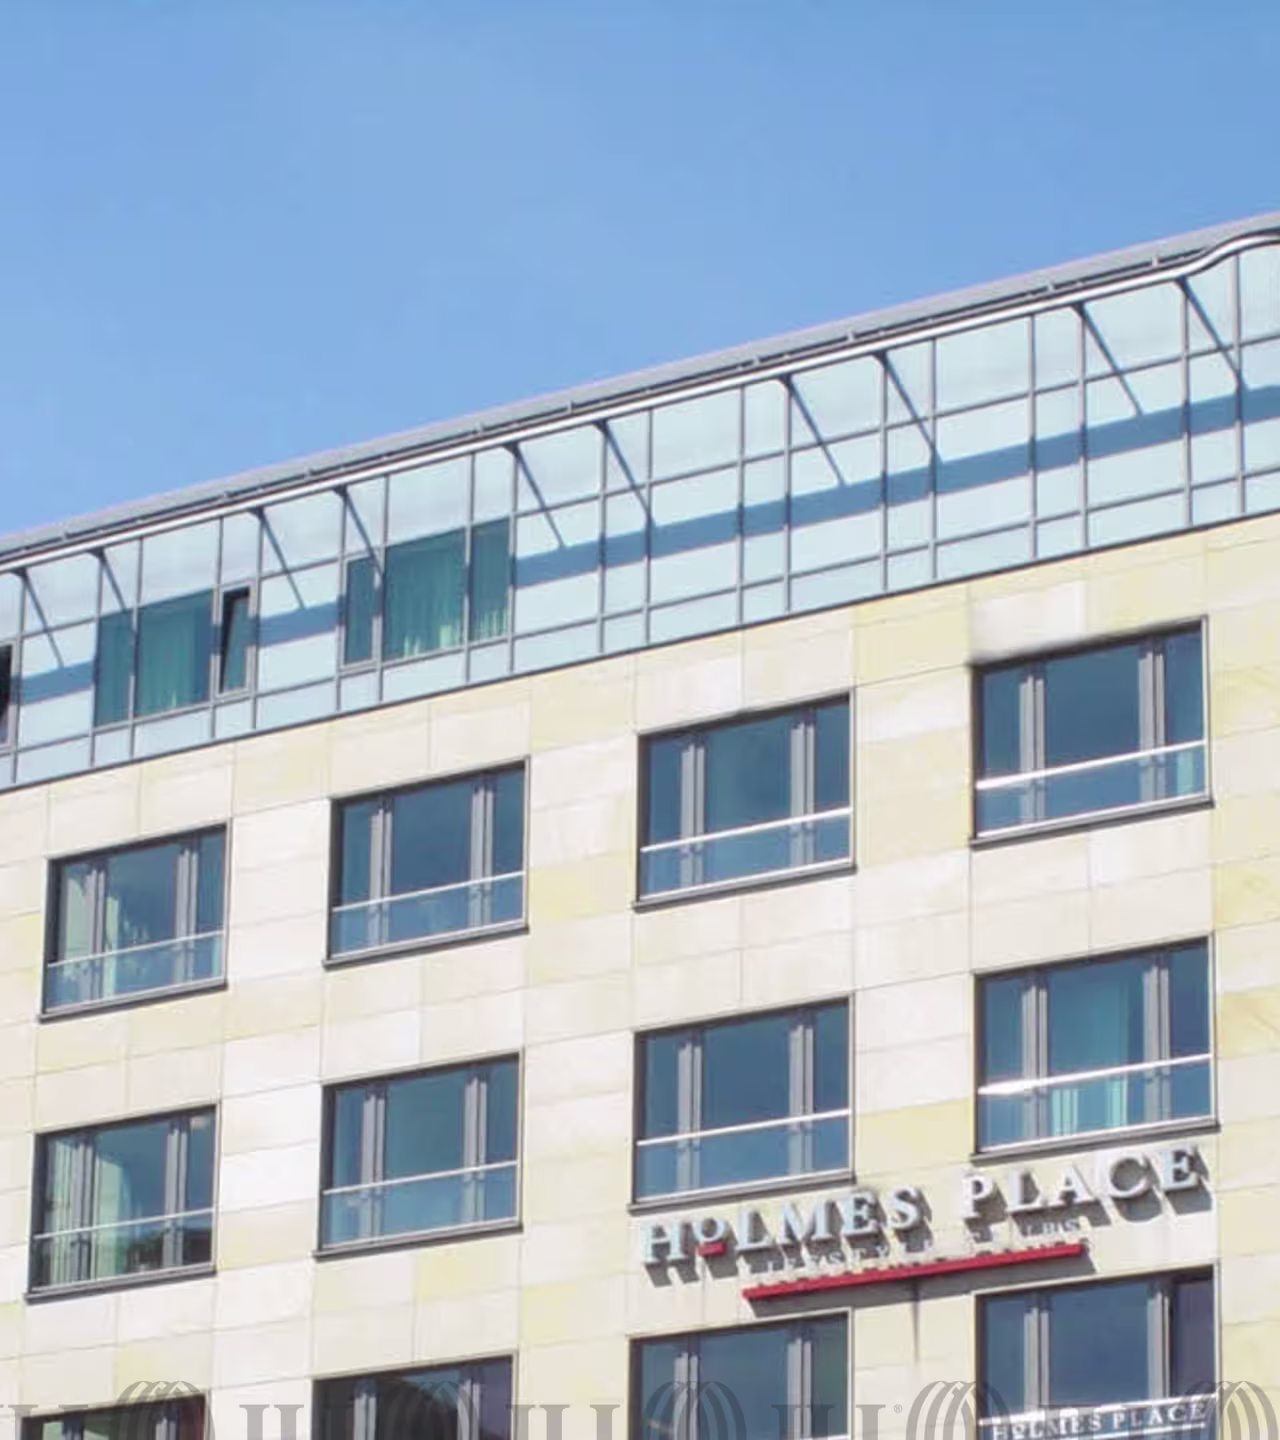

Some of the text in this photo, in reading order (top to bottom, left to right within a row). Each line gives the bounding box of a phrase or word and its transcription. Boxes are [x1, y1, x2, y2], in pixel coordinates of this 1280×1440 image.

[642, 1142, 1202, 1263] HOLMES PLACE
[1112, 1401, 1206, 1430] PLACE
